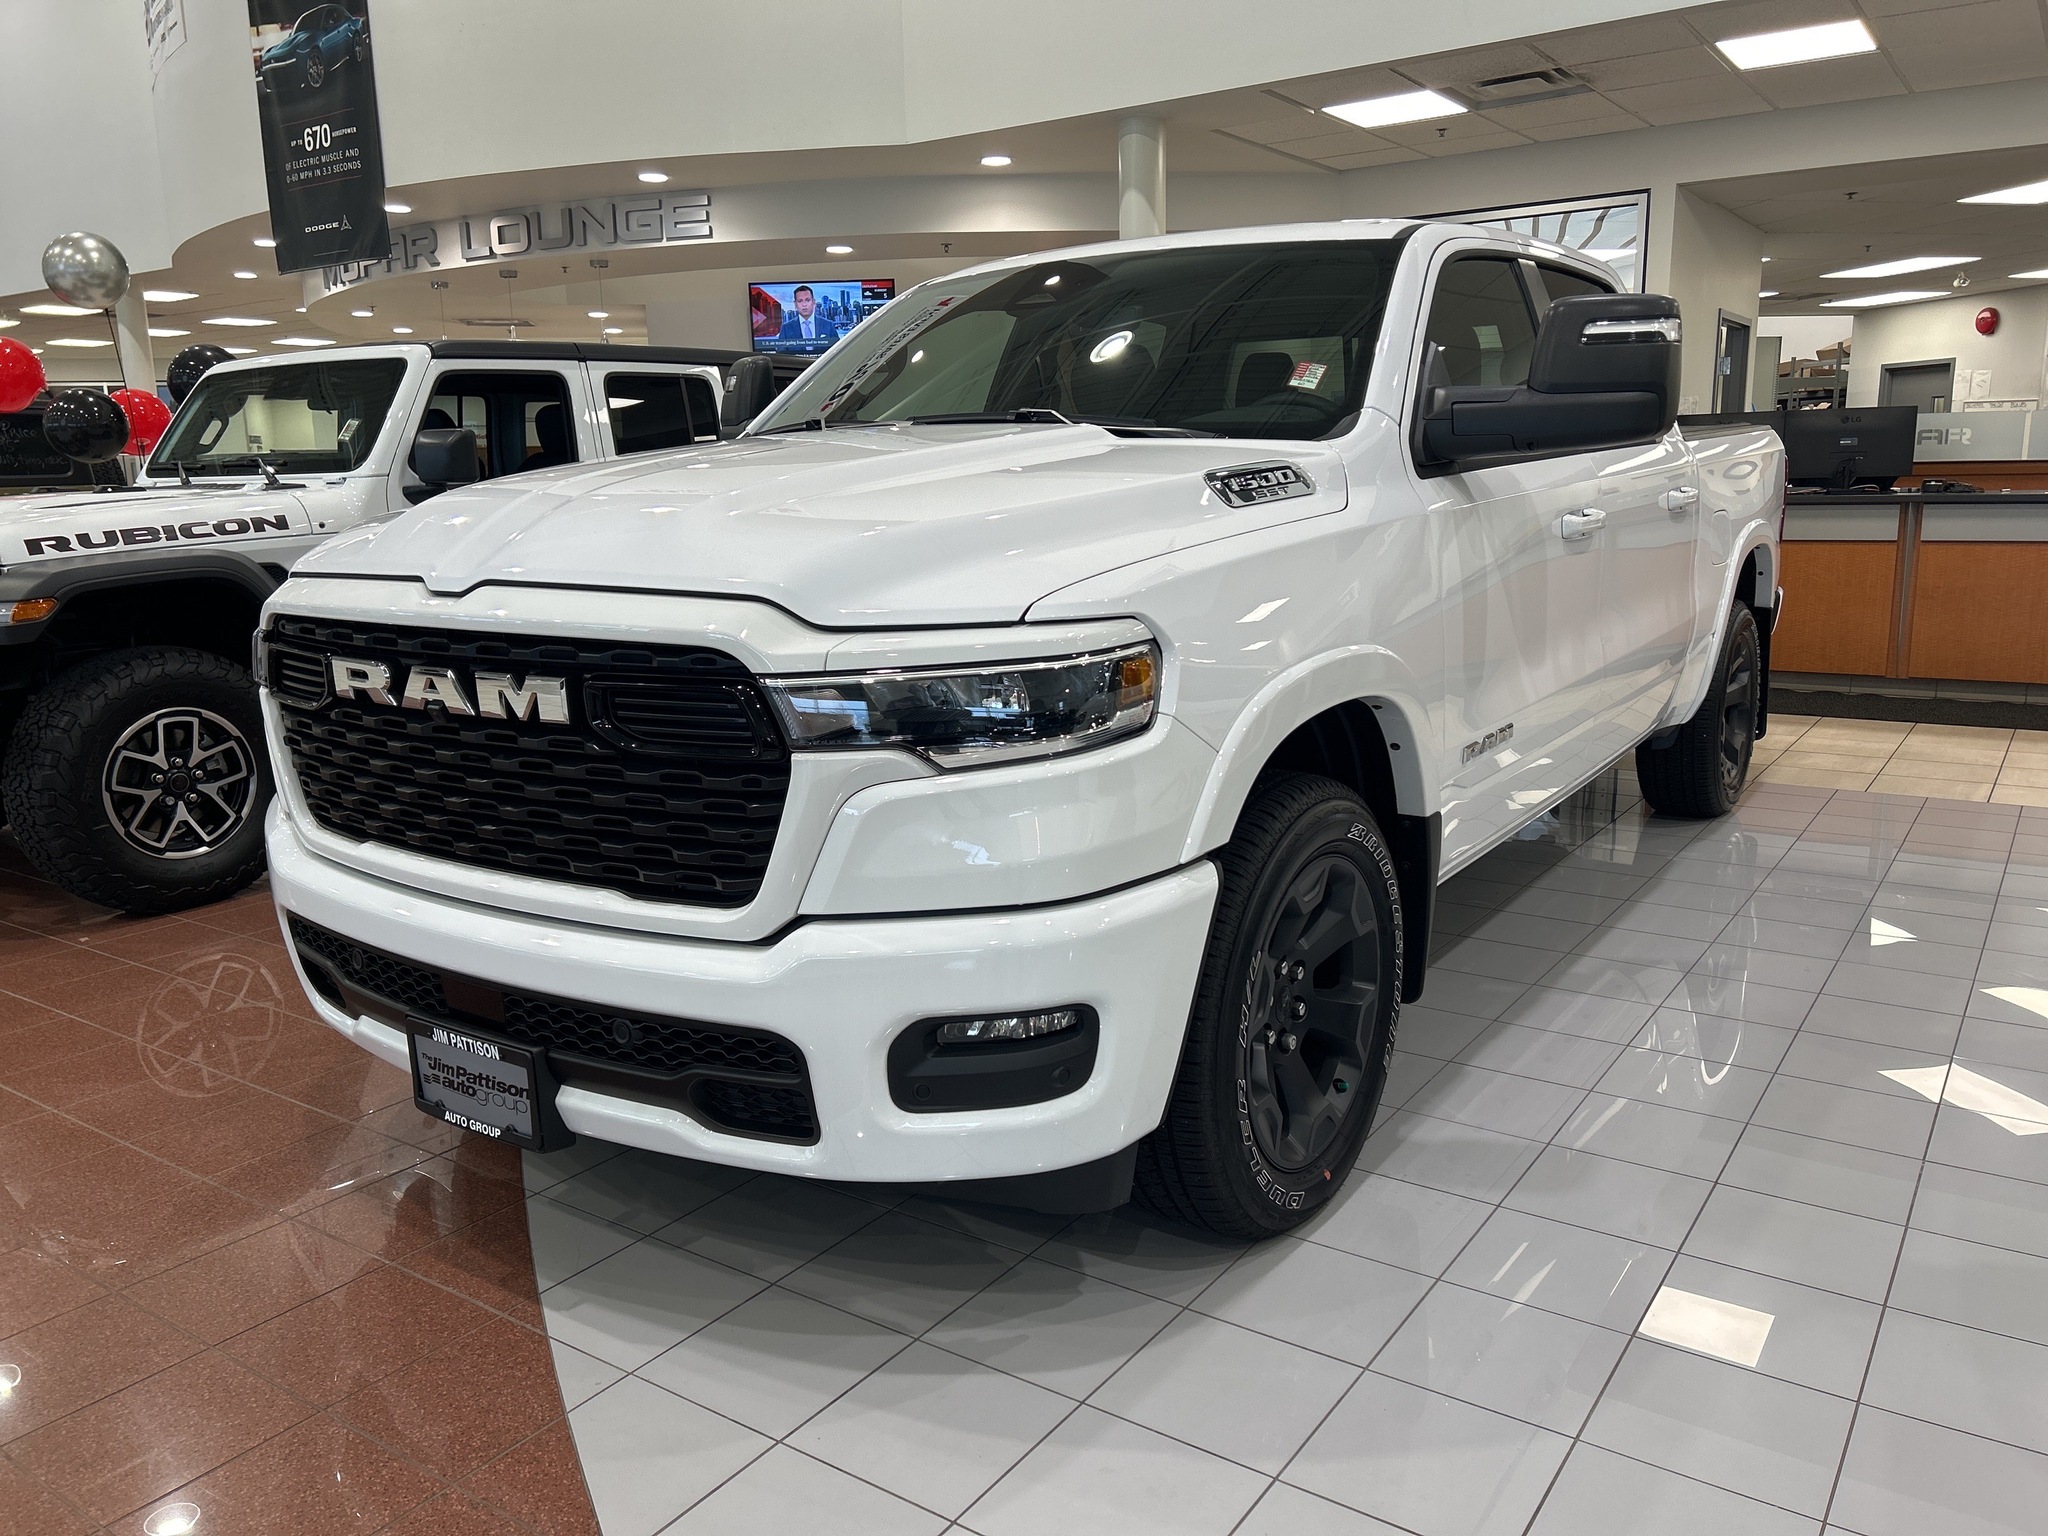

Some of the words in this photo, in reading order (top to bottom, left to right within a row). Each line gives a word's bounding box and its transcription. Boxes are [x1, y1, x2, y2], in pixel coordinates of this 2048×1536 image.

[304, 123, 331, 151] 670
[285, 162, 292, 172] OF
[292, 156, 320, 170] ELECTRIC
[321, 150, 343, 163] MUSCLE
[345, 147, 360, 158] AND
[286, 173, 299, 184] 0-60
[299, 169, 313, 180] MPH
[314, 168, 321, 177] IN
[322, 166, 332, 176] 3.3
[332, 160, 362, 173] SECONDS
[305, 222, 339, 233] DODGE
[459, 193, 713, 262] LOUNGE
[1226, 469, 1296, 492] 1500
[1253, 485, 1289, 500] SST
[24, 514, 290, 557] RUBICON
[331, 656, 571, 724] RAM
[1460, 722, 1514, 765] RAM
[1346, 821, 1404, 1075] BRIDGESTONE
[421, 1051, 434, 1063] The
[432, 1027, 450, 1046] JIM
[450, 1033, 499, 1060] PATTISON
[444, 1110, 469, 1128] AUTO
[469, 1119, 502, 1139] GROUP
[1237, 1077, 1305, 1210] DUELER
